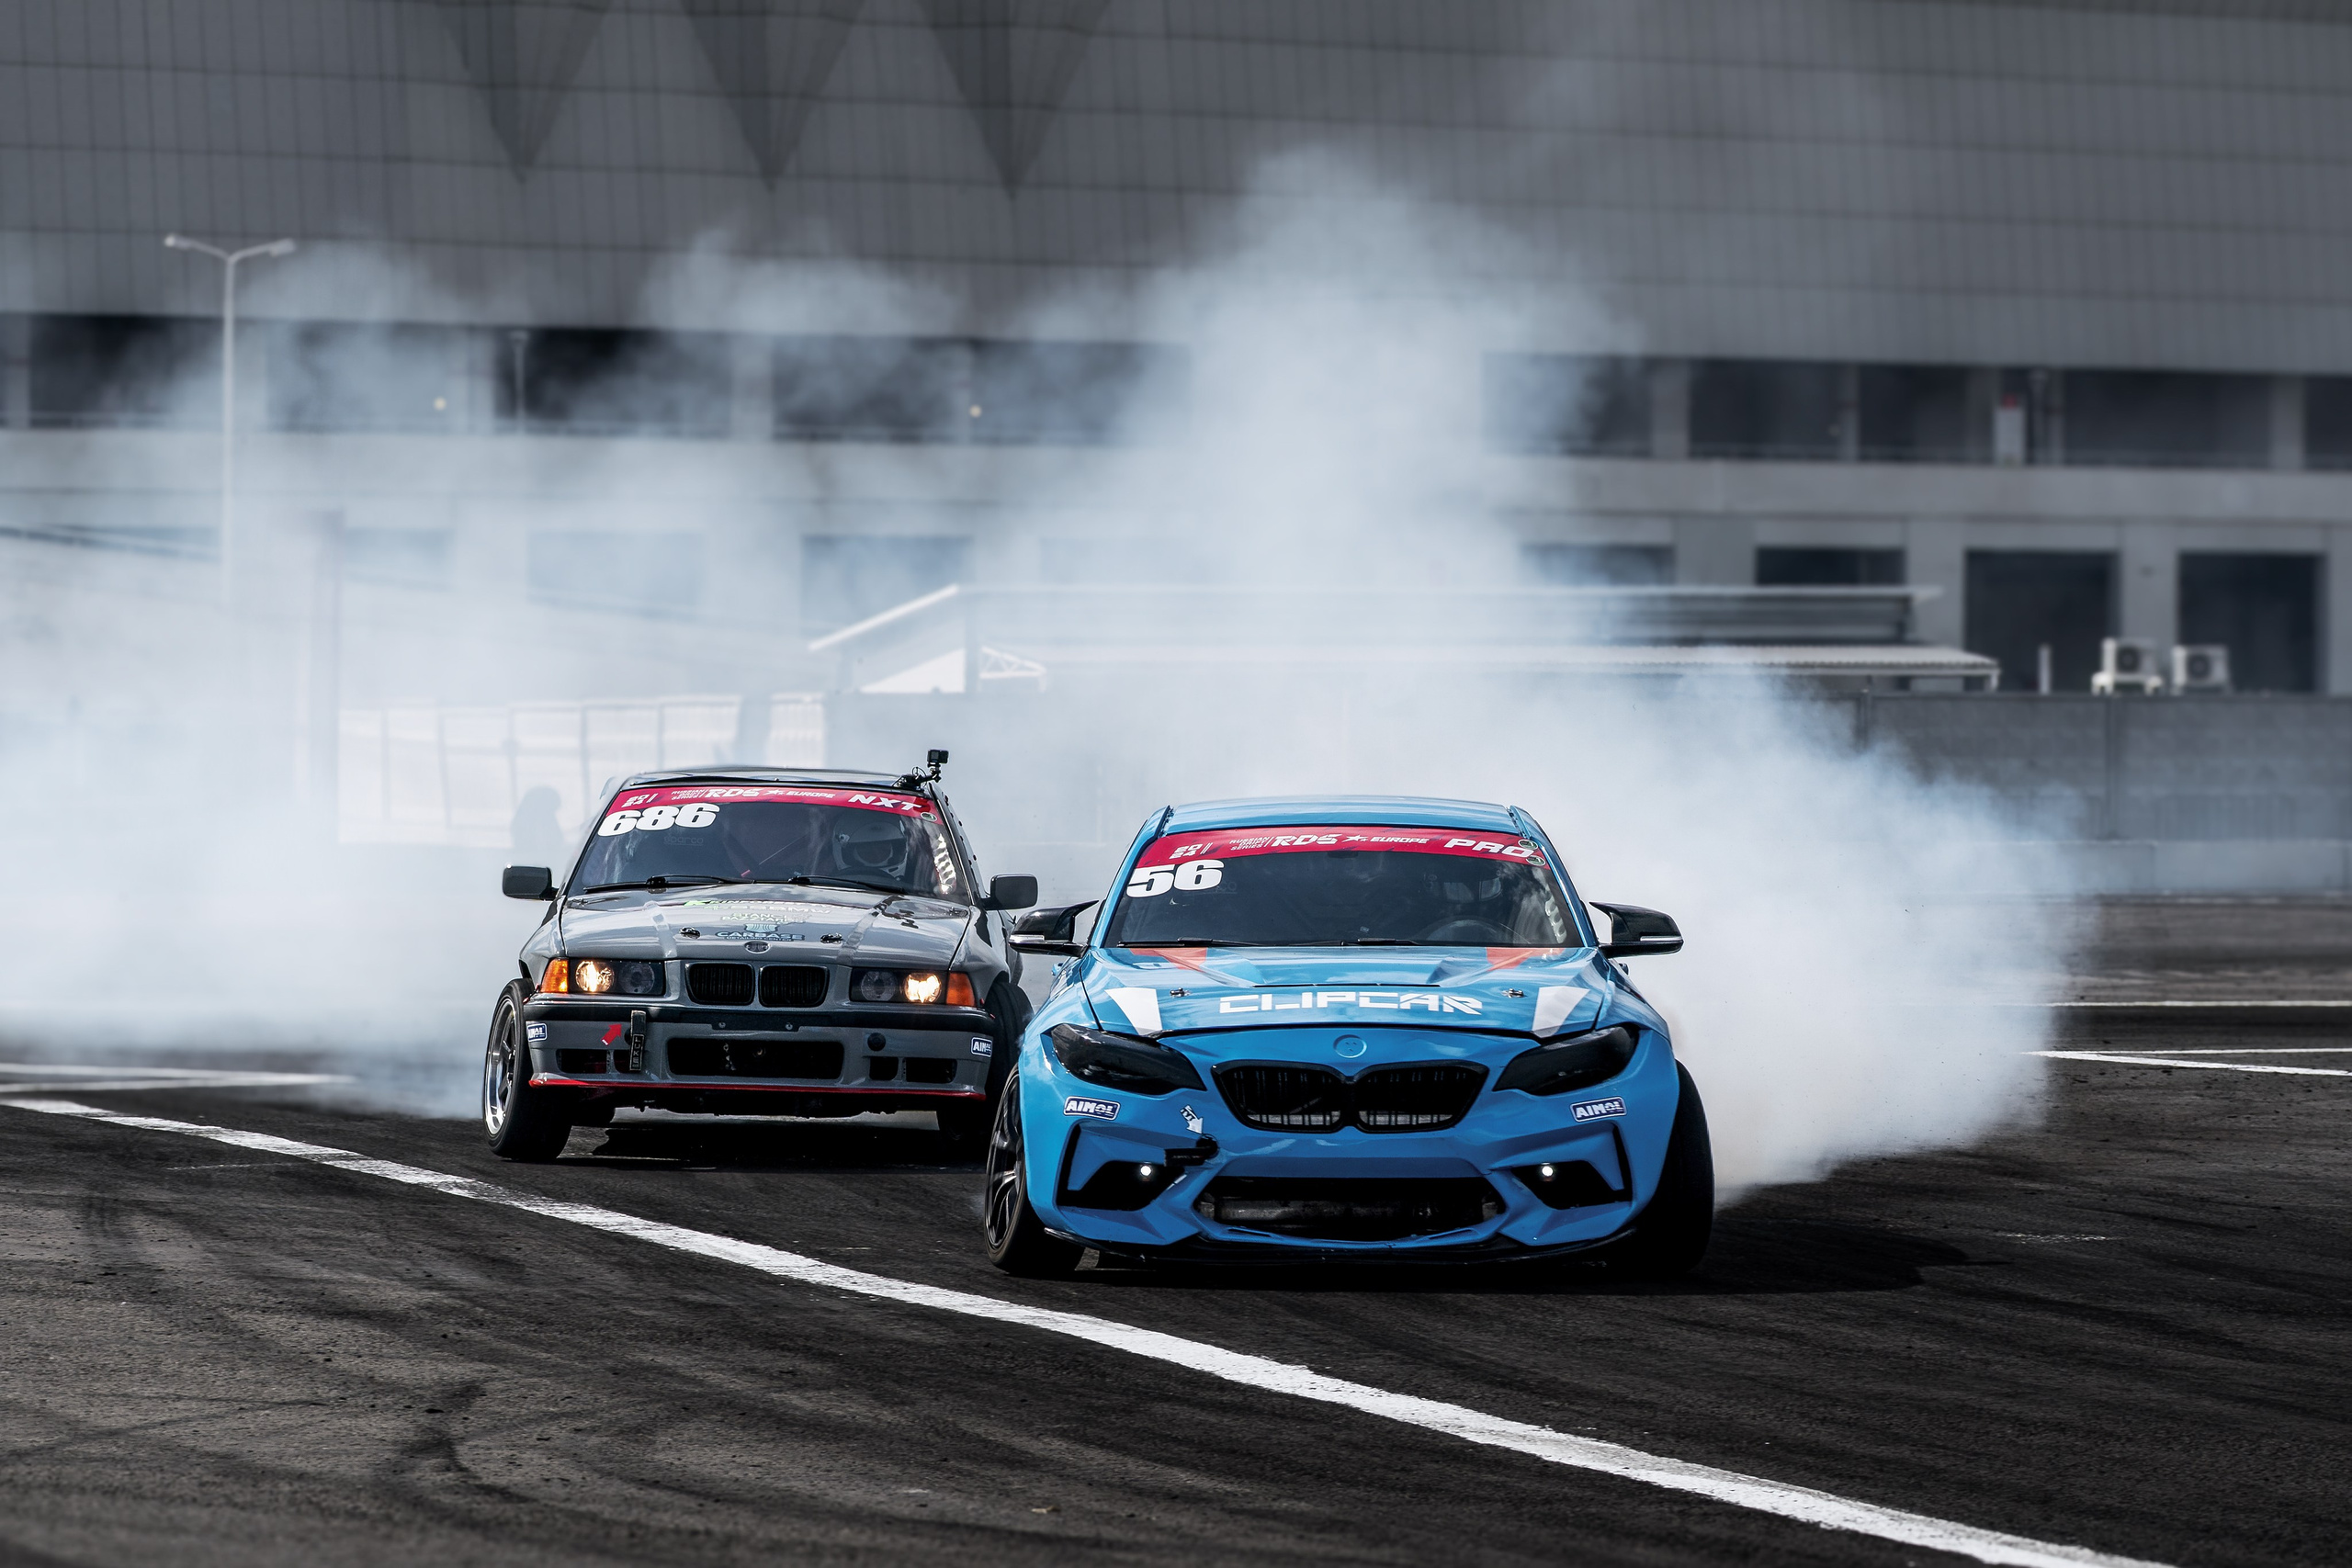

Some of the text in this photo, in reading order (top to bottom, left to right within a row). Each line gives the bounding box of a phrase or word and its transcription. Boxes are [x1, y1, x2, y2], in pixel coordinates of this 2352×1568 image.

[784, 790, 836, 799] EUROPE
[848, 794, 922, 812] NXT
[597, 802, 720, 837] 686
[1370, 836, 1431, 844] EUROPE
[1443, 838, 1534, 858] PRO
[1125, 859, 1225, 898] 56
[716, 931, 805, 941] CARBASE
[1219, 991, 1483, 1016] CLIPCAR
[1066, 1100, 1115, 1116] AIMOL
[1576, 1100, 1624, 1118] AIMOL
